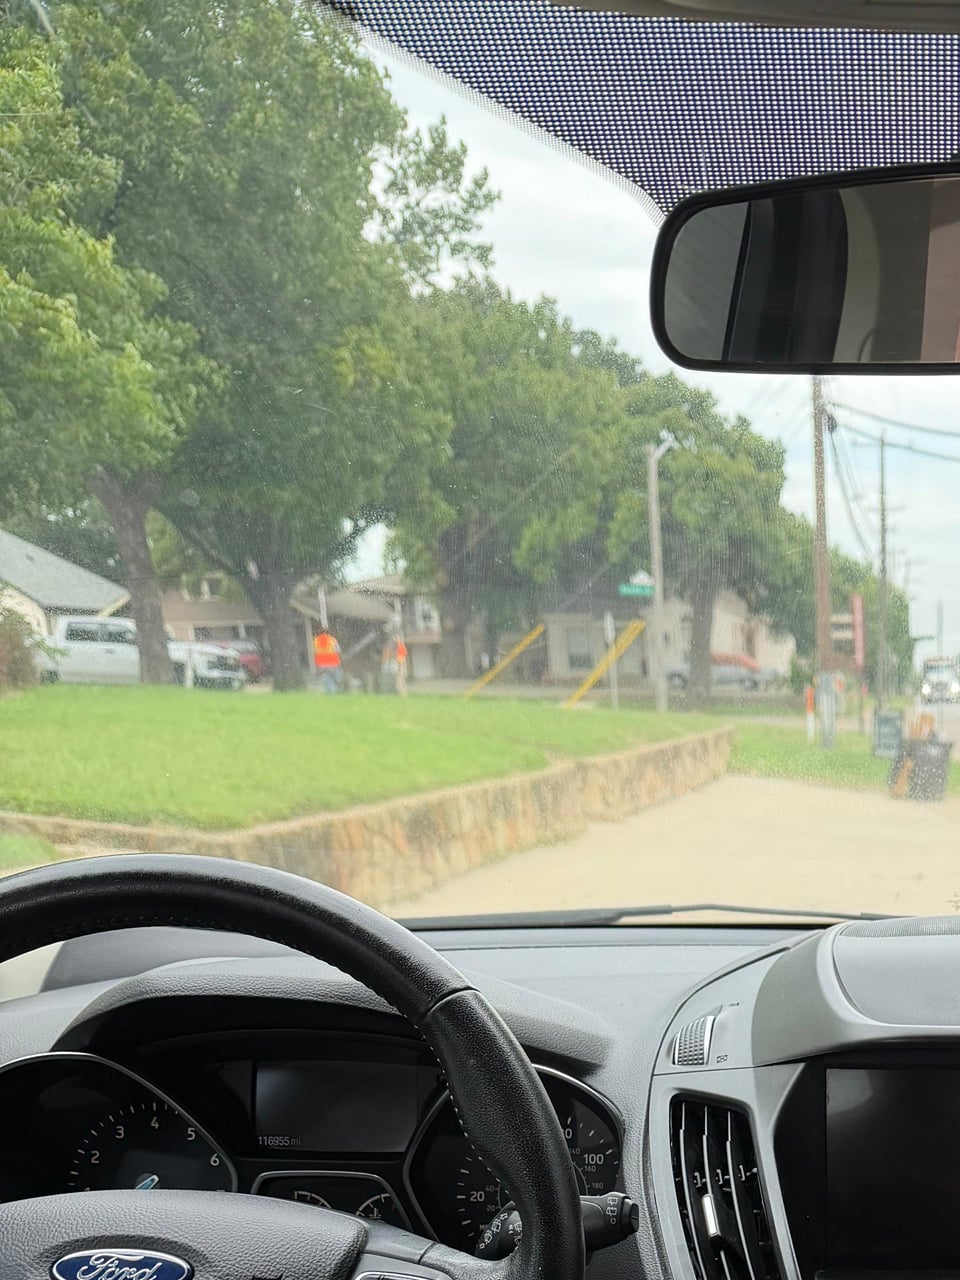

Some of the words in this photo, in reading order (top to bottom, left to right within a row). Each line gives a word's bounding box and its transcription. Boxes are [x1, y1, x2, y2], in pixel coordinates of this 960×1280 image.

[150, 1116, 160, 1130] 4
[114, 1125, 125, 1140] 3
[186, 1127, 196, 1141] 5
[90, 1150, 100, 1164] 2
[209, 1152, 220, 1167] 6
[583, 1154, 604, 1164] 100
[470, 1191, 485, 1202] 20
